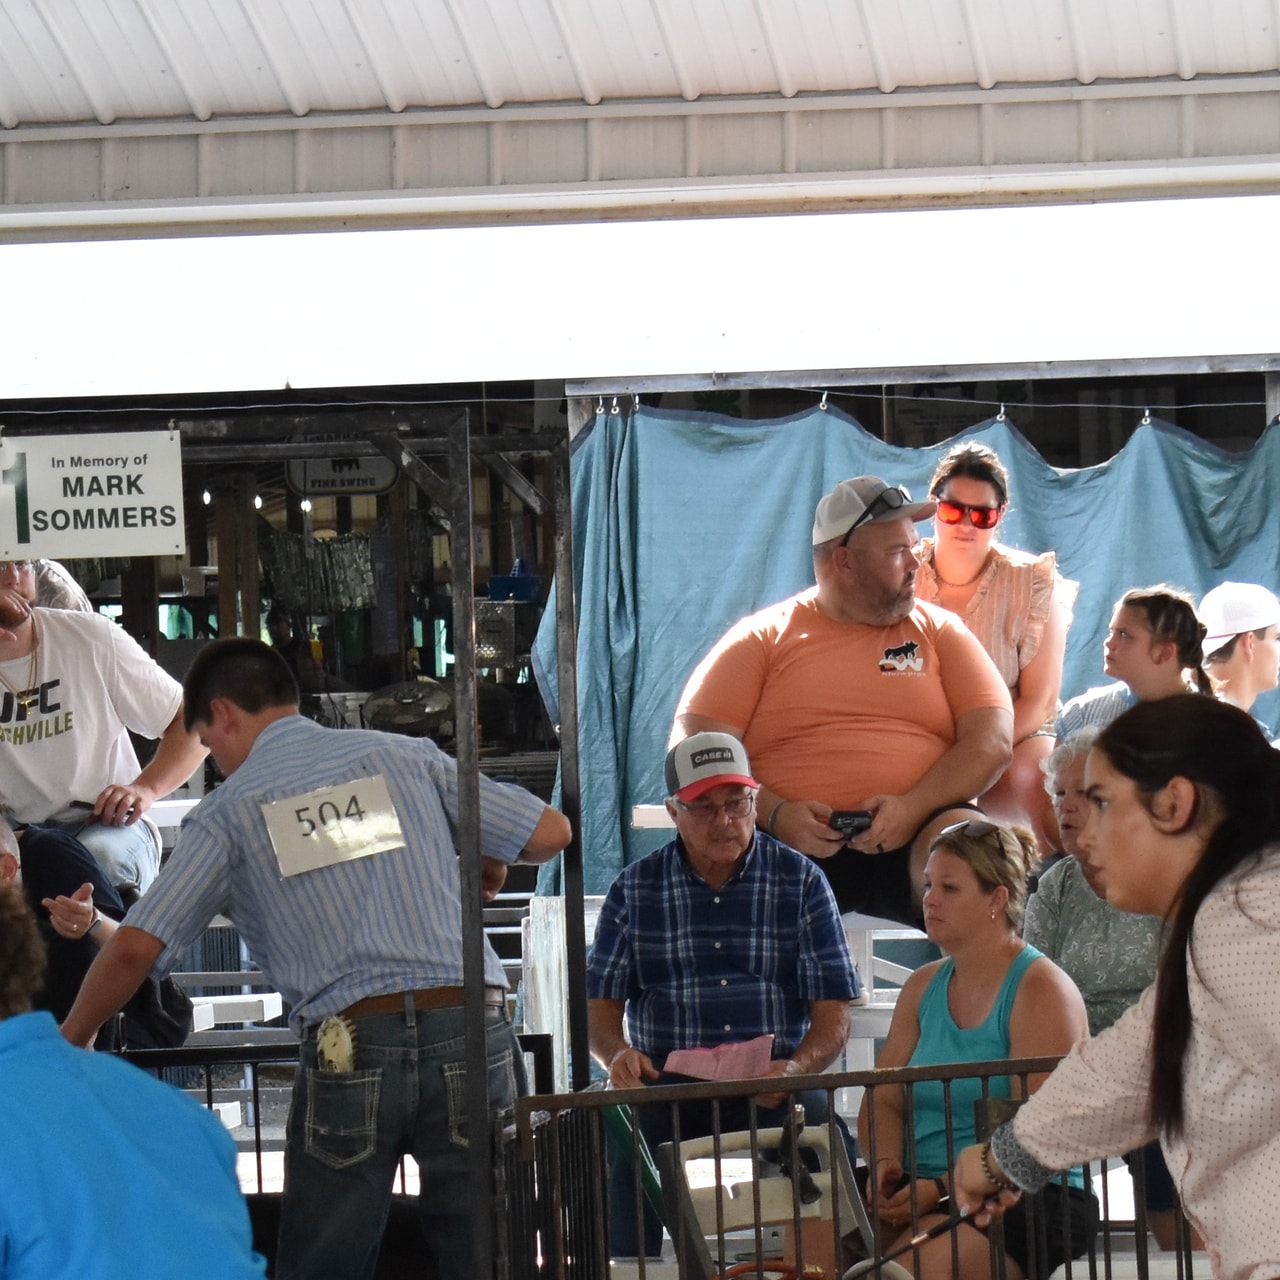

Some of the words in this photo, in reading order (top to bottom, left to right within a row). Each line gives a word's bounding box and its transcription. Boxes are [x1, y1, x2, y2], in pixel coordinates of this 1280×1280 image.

[51, 457, 65, 468] In
[70, 455, 129, 470] Memory
[134, 453, 148, 465] of
[62, 473, 144, 498] MARK
[340, 477, 376, 488] SWINE
[2, 452, 30, 544] 1
[32, 504, 177, 532] SOMMERS
[694, 751, 722, 763] CASE
[295, 794, 366, 837] 504
